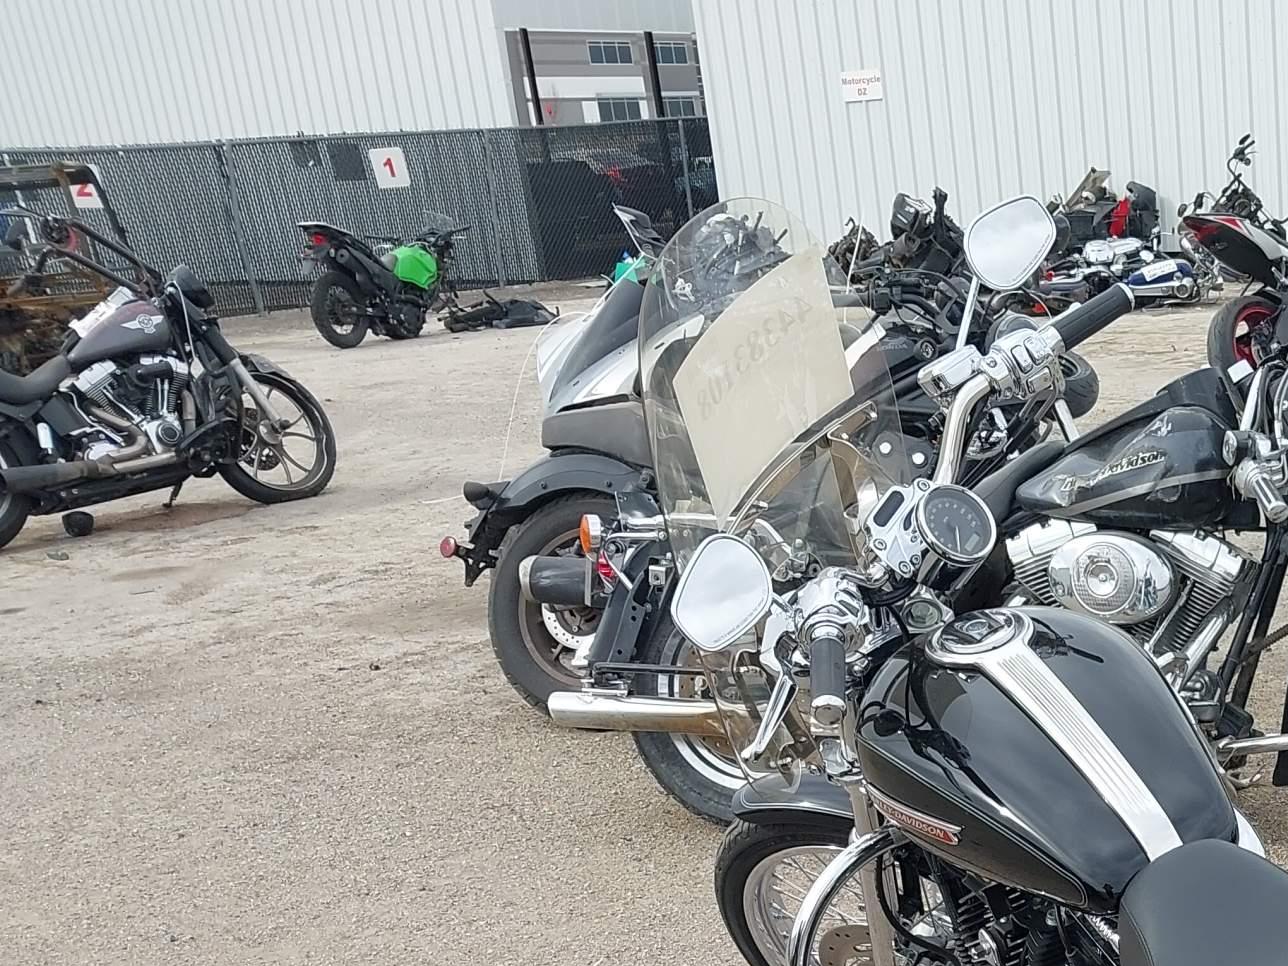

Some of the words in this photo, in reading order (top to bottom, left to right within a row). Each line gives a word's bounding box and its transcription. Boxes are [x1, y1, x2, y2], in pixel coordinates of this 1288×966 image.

[841, 75, 881, 86] Motorcycle
[857, 87, 868, 96] DZ
[383, 157, 396, 178] 1
